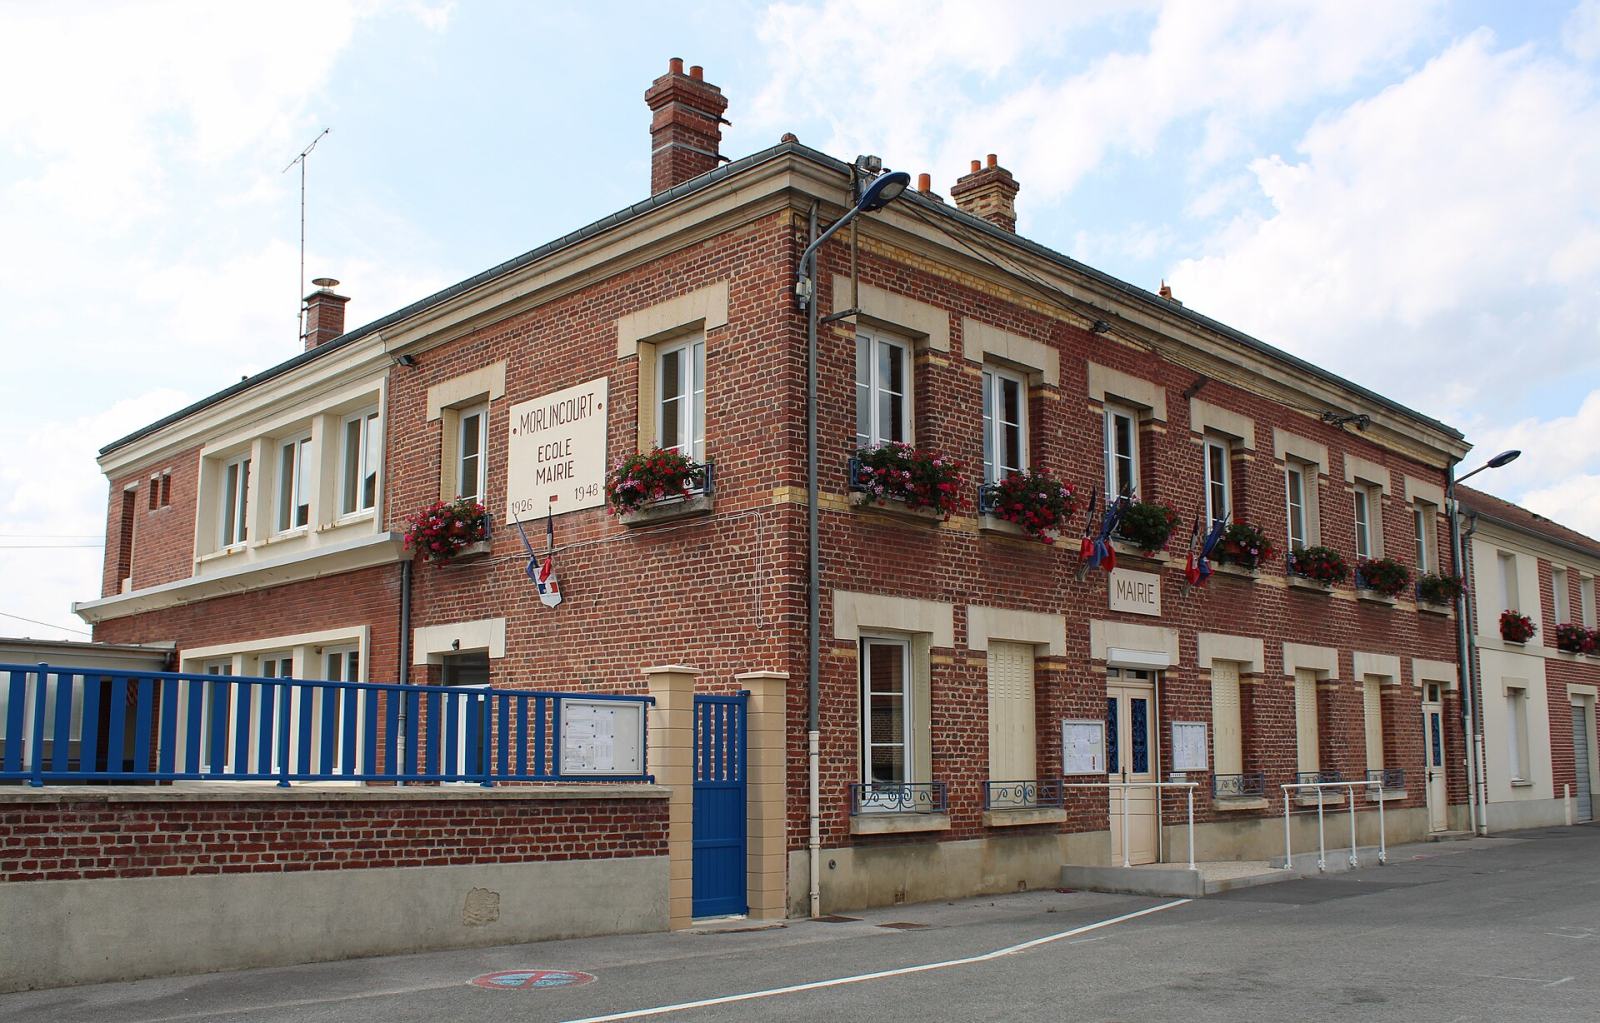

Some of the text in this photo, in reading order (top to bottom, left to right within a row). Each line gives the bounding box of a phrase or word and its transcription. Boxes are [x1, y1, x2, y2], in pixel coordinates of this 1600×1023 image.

[520, 393, 594, 436] MORLINCOURT
[537, 438, 572, 463] ECOLE
[536, 460, 575, 485] MAIRIE
[575, 483, 599, 501] 1948
[511, 498, 533, 515] 1926
[1117, 579, 1155, 604] MAIRIE
